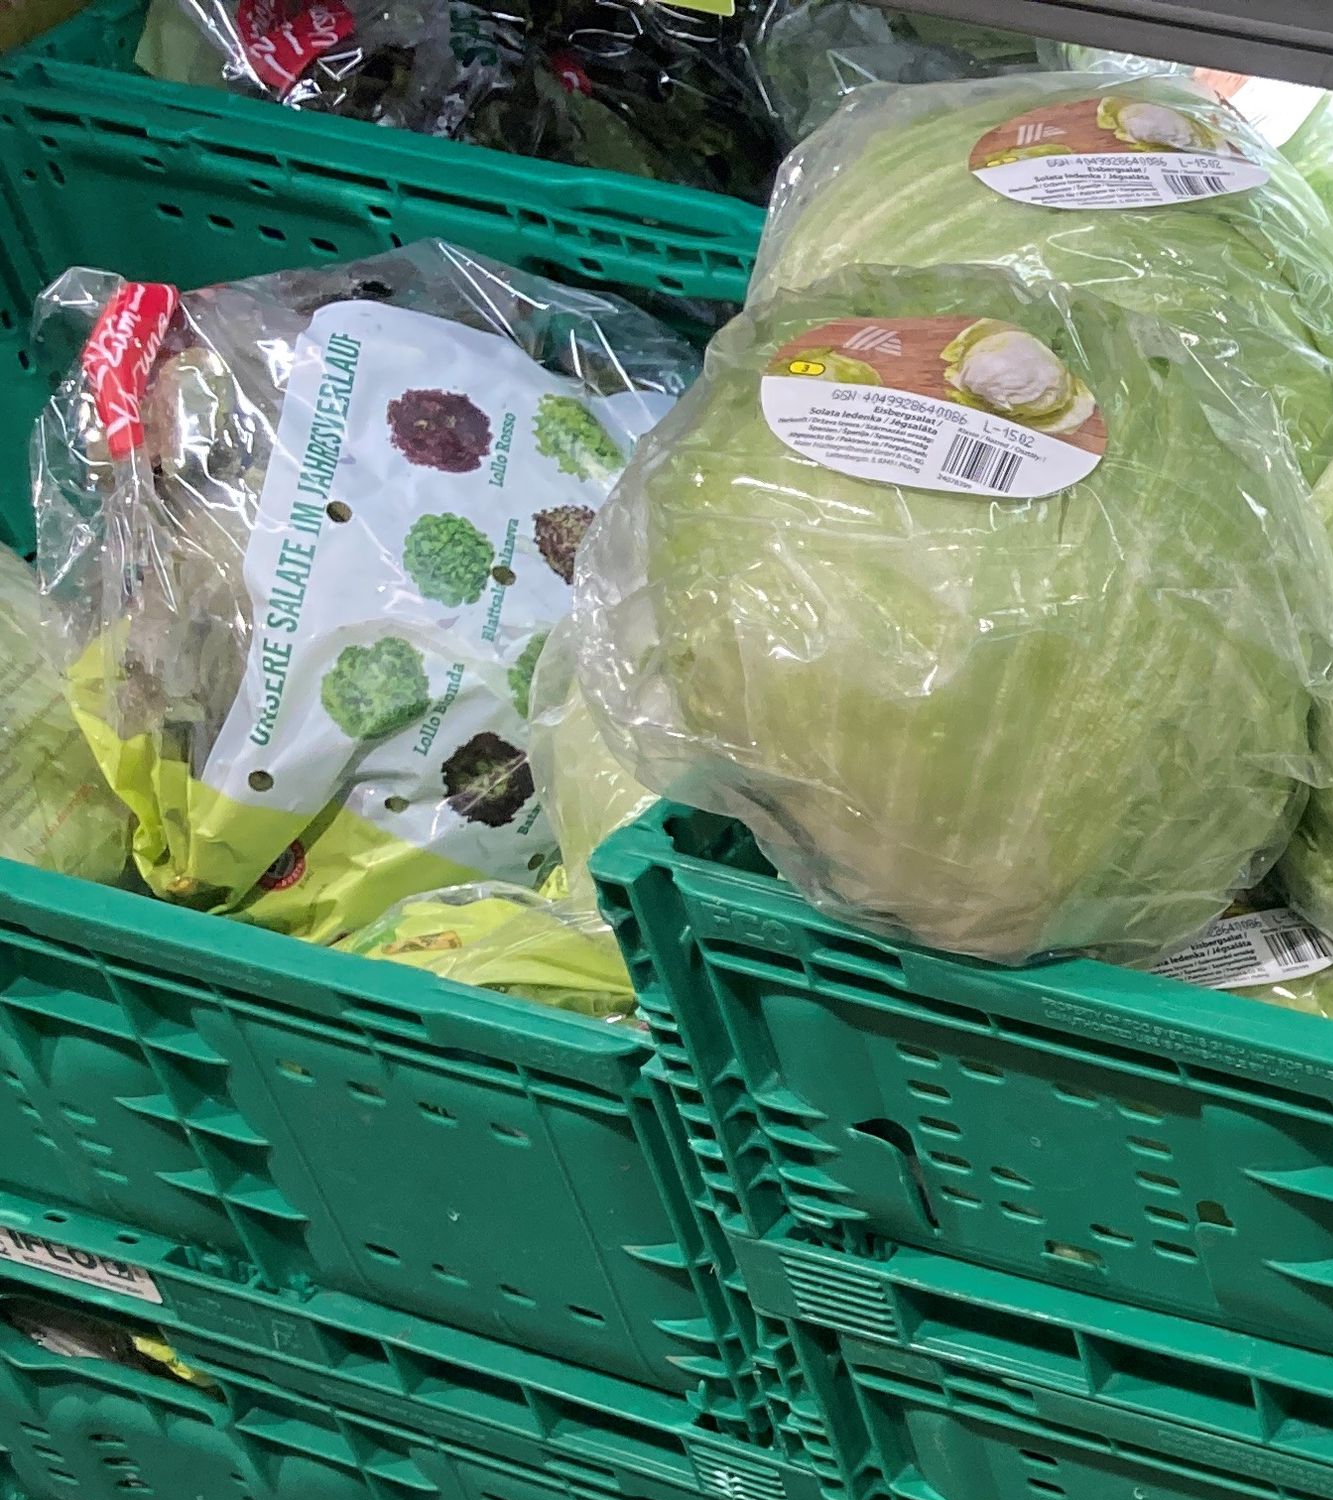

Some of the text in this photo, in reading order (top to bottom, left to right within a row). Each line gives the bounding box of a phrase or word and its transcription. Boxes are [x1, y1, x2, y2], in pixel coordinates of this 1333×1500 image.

[810, 407, 840, 417] Solata
[842, 409, 882, 423] ledenka
[873, 406, 936, 425] Eisbergsalat
[488, 412, 517, 488] Lollo Rosso
[982, 419, 1036, 450] L-1502
[249, 330, 363, 747] UNSERE SALATE IM JAHRESVERLAUF
[412, 717, 441, 757] Lollo
